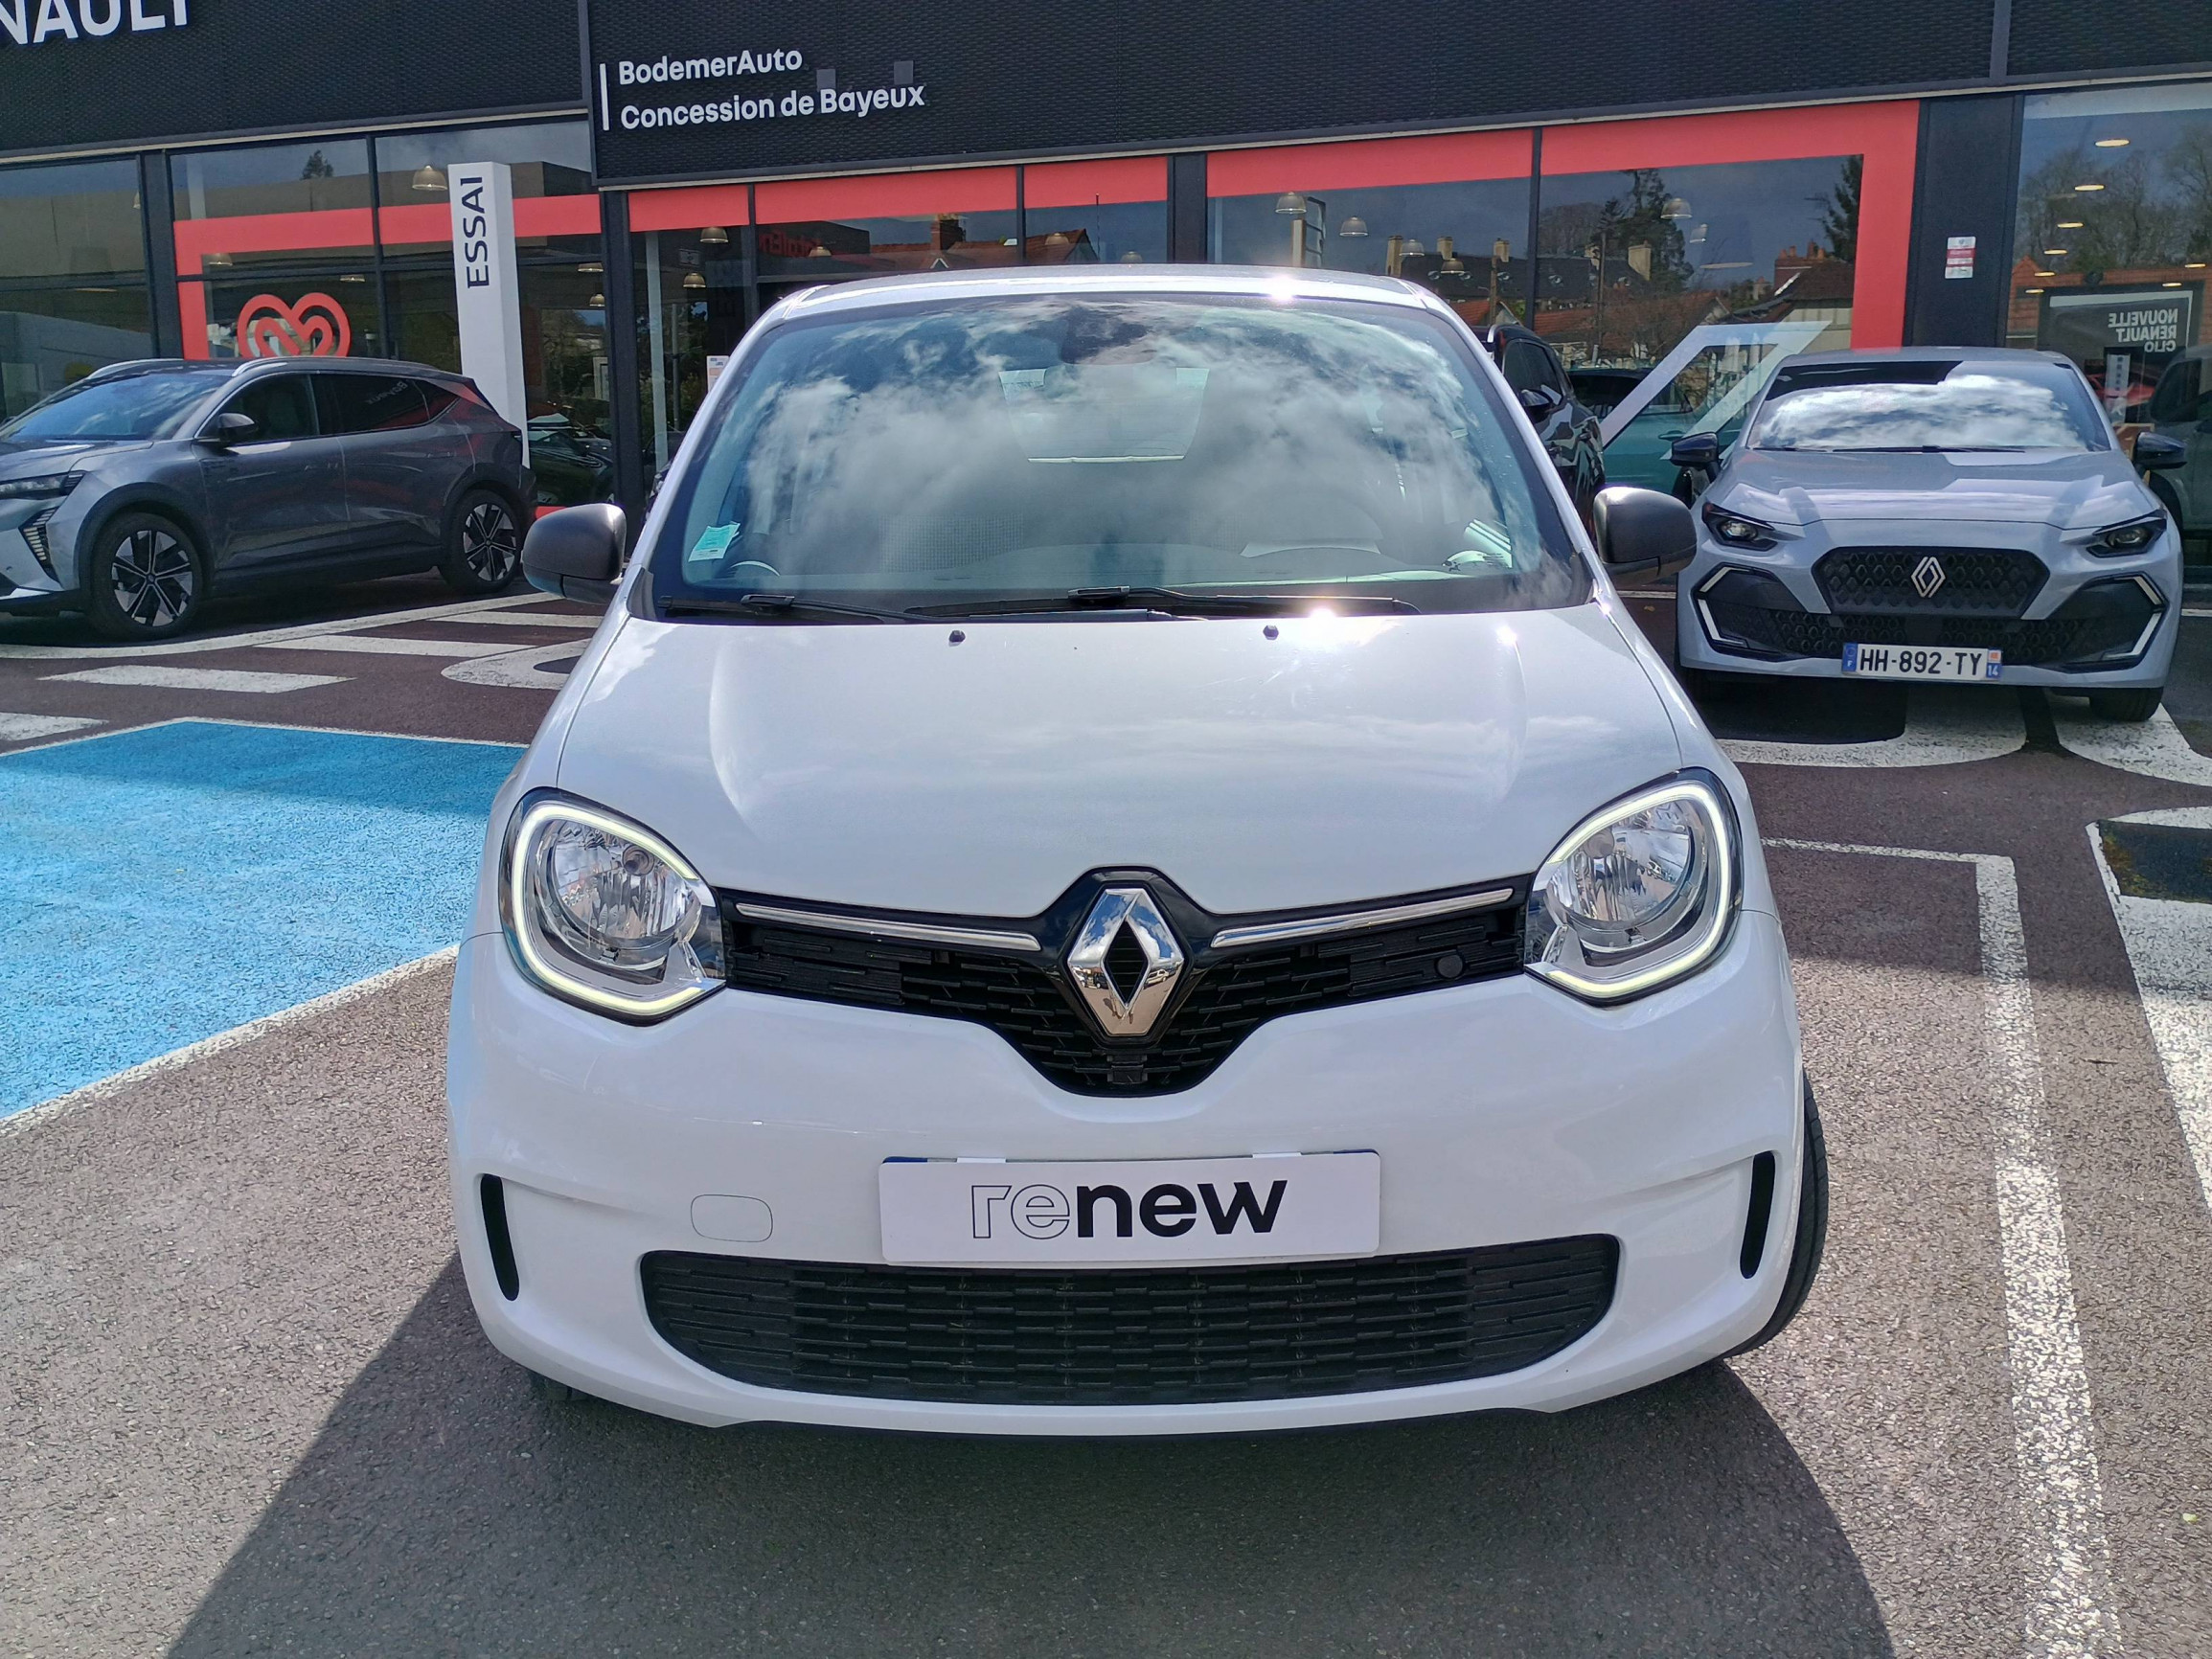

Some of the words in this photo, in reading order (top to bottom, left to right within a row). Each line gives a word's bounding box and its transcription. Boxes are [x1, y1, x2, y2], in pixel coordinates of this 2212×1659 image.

[619, 49, 803, 85] BodemerAuto
[620, 95, 775, 130] Concession
[780, 90, 814, 117] de
[820, 85, 925, 118] Bayeux
[460, 176, 490, 289] ESSAI
[1859, 648, 1982, 675] HH-892-TY
[1988, 665, 1998, 676] 14
[970, 1179, 1288, 1239] renew
